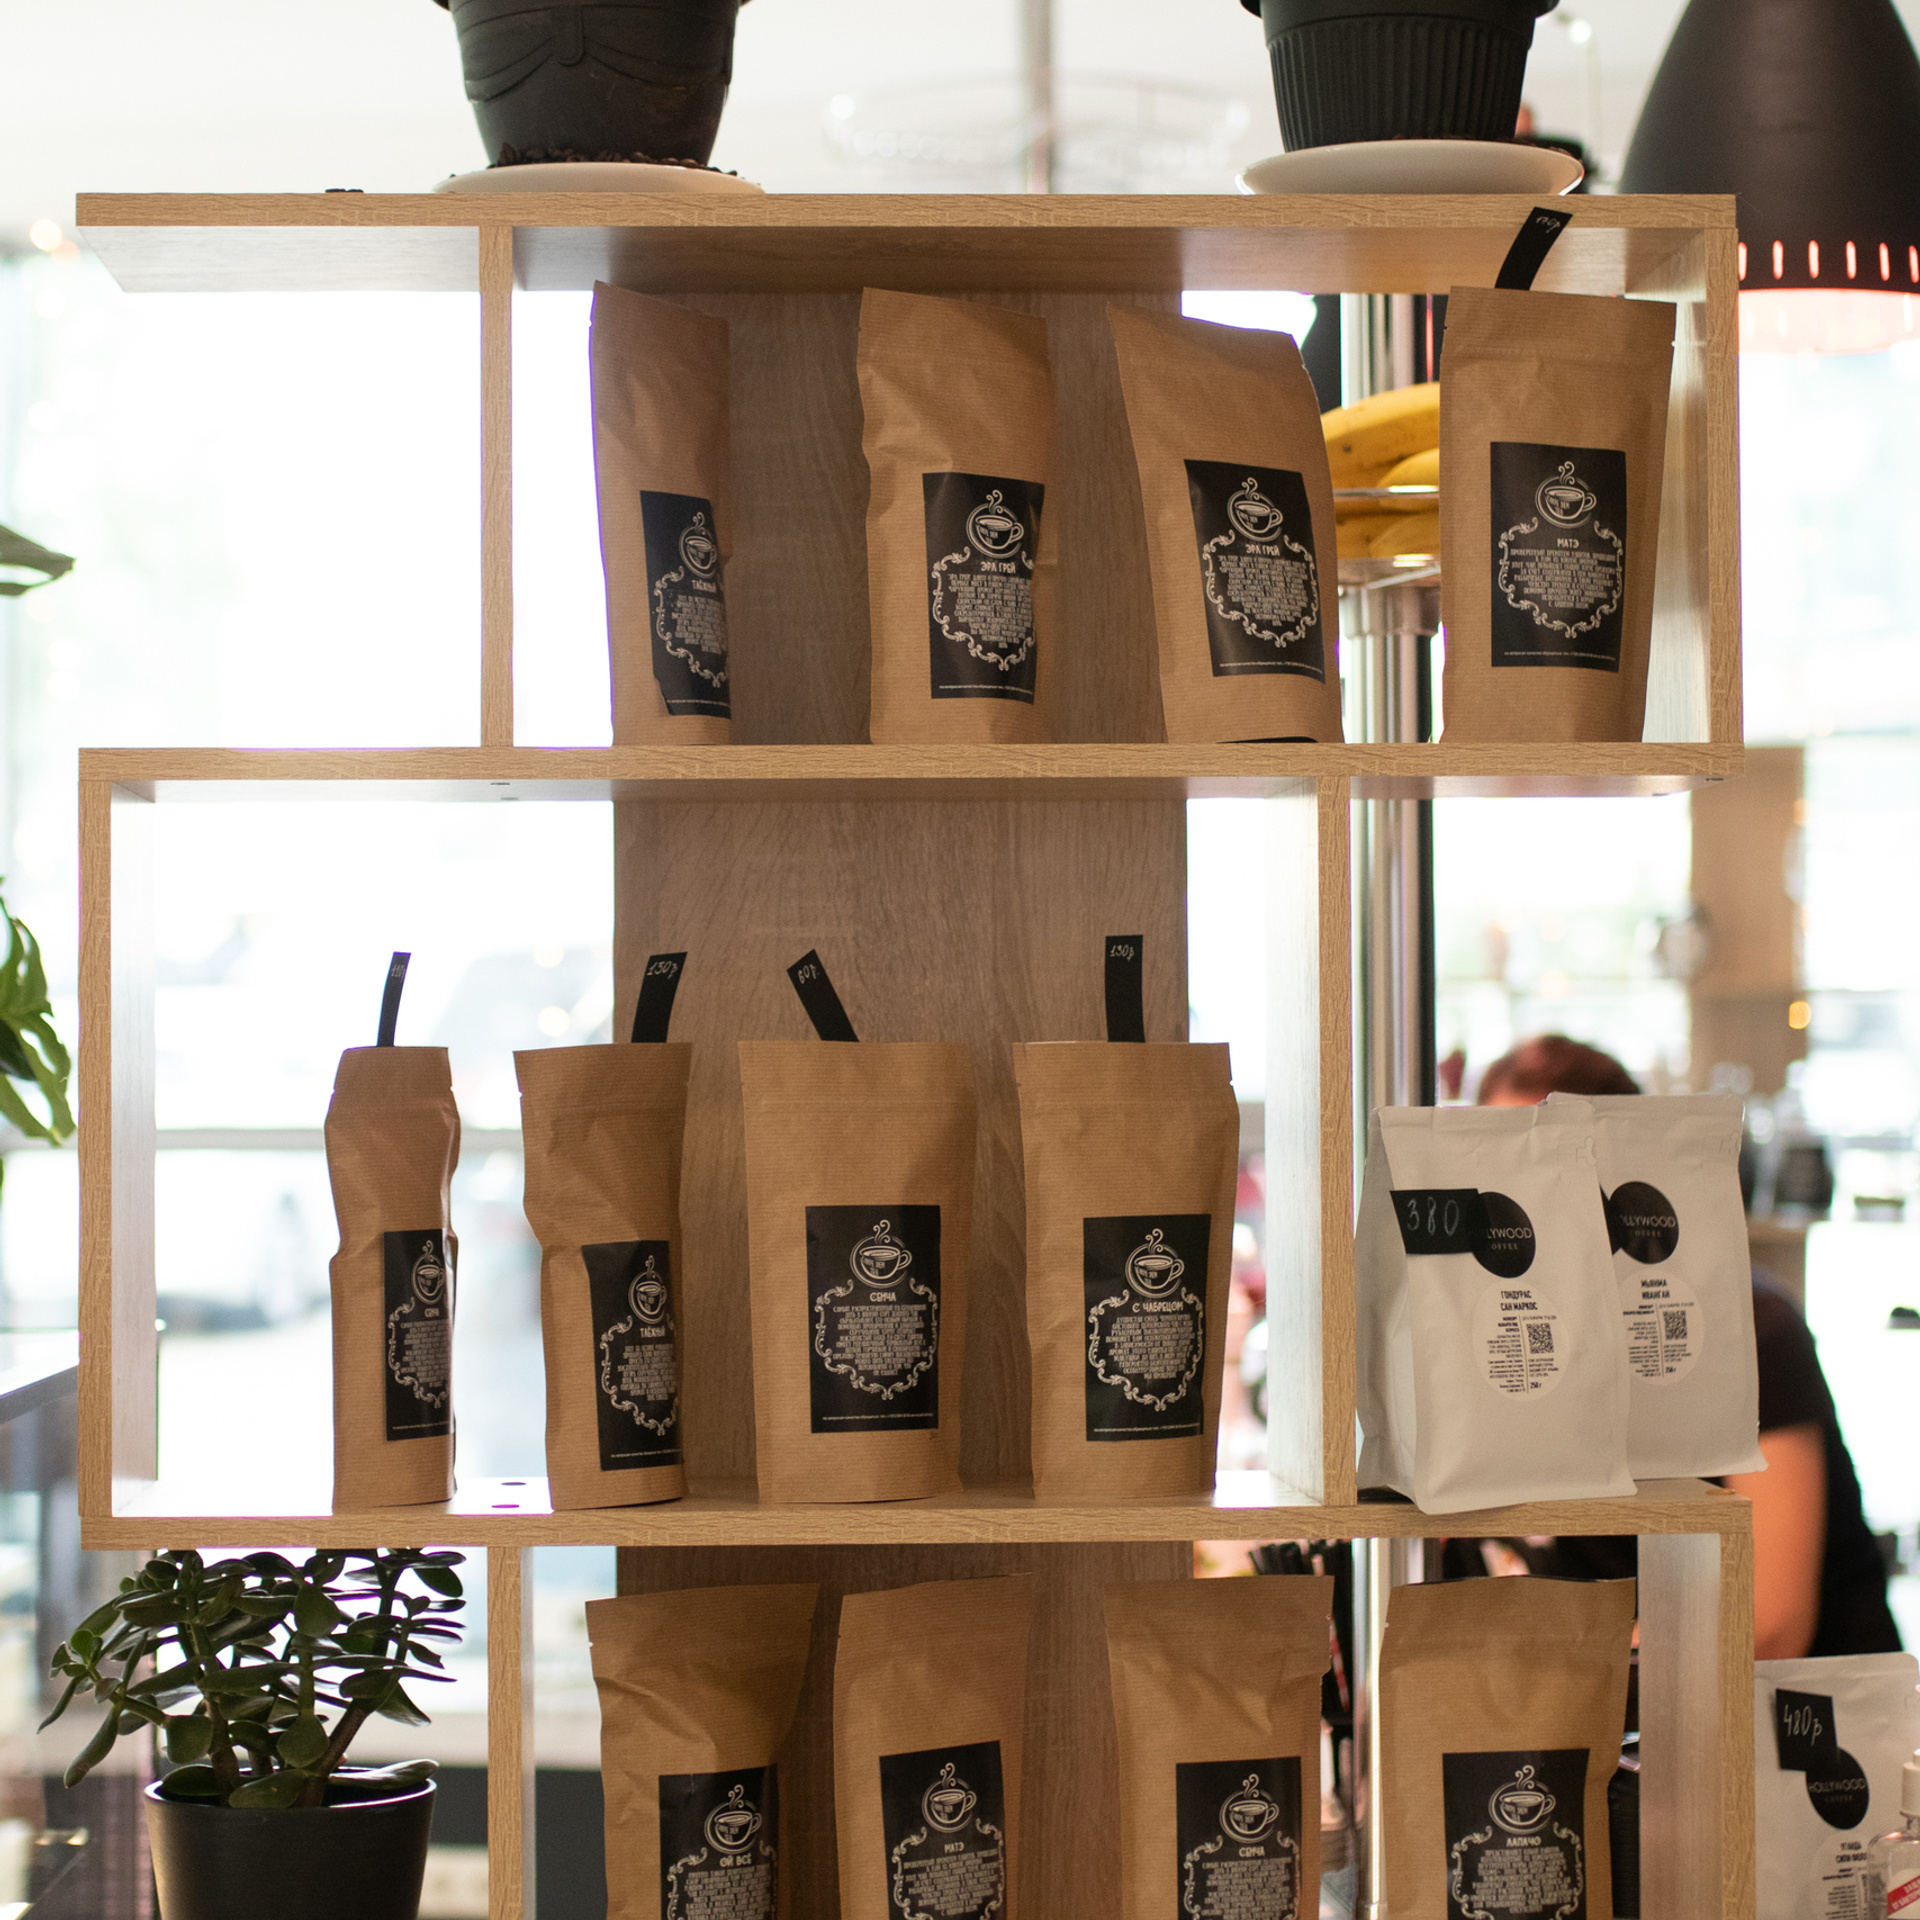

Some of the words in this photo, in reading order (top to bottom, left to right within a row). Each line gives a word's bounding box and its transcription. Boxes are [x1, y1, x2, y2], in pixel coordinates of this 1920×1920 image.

[1557, 538, 1580, 549] МАТЭ
[1407, 1196, 1460, 1237] 380
[869, 1292, 897, 1302] СЕНЧА
[1500, 1290, 1532, 1300] ГОНДУРАС
[1132, 1303, 1140, 1313] С
[1142, 1301, 1184, 1313] ЧАБРЕЦОМ
[1500, 1302, 1512, 1311] САН
[1513, 1302, 1538, 1311] МАРКОС
[1783, 1704, 1823, 1747] 480р
[944, 1842, 965, 1854] МАТЭ
[1506, 1836, 1542, 1848] ЛАПАЧО
